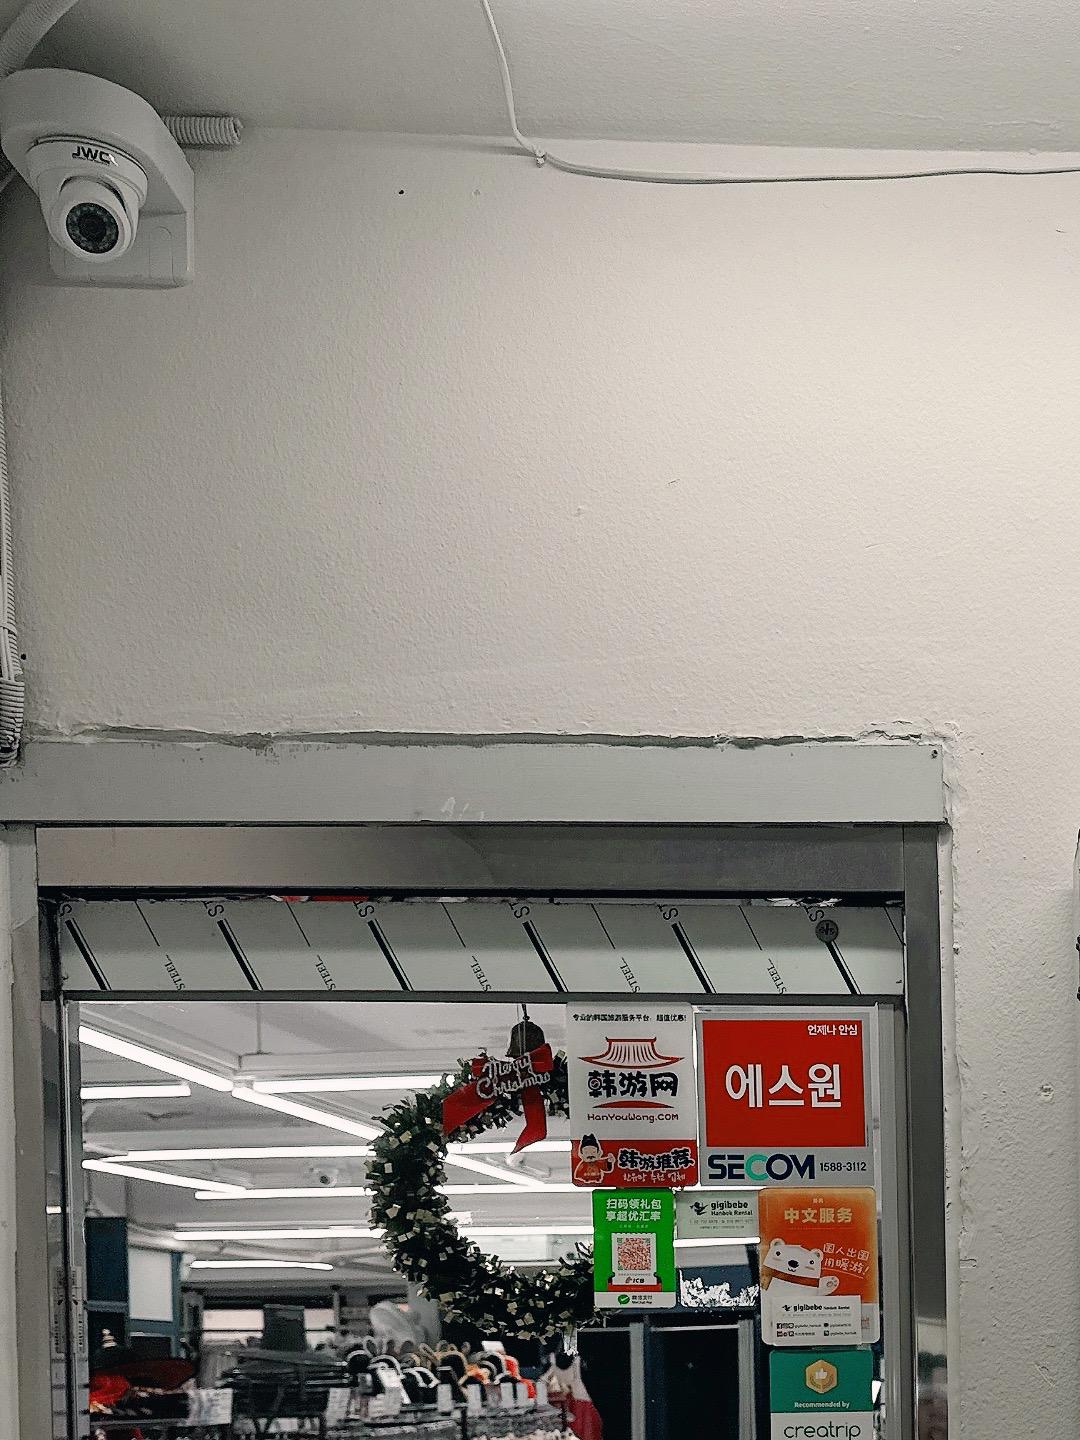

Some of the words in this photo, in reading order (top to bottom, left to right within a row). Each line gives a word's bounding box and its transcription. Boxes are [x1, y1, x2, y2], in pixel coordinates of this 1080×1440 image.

[807, 1024, 836, 1036] 언제나
[838, 1024, 858, 1036] 안심
[588, 1070, 679, 1099] 韩游网
[725, 1063, 842, 1108] 에스원
[587, 1113, 679, 1124] HanYouWang.COM
[707, 1153, 816, 1181] SECOM
[819, 1161, 867, 1172] 1588-3112
[606, 1198, 662, 1210] 扫码领礼包
[710, 1200, 749, 1211] gigibebe
[606, 1210, 661, 1222] 享超优汇率
[783, 1207, 853, 1224] 中文服务
[842, 1401, 851, 1409] by
